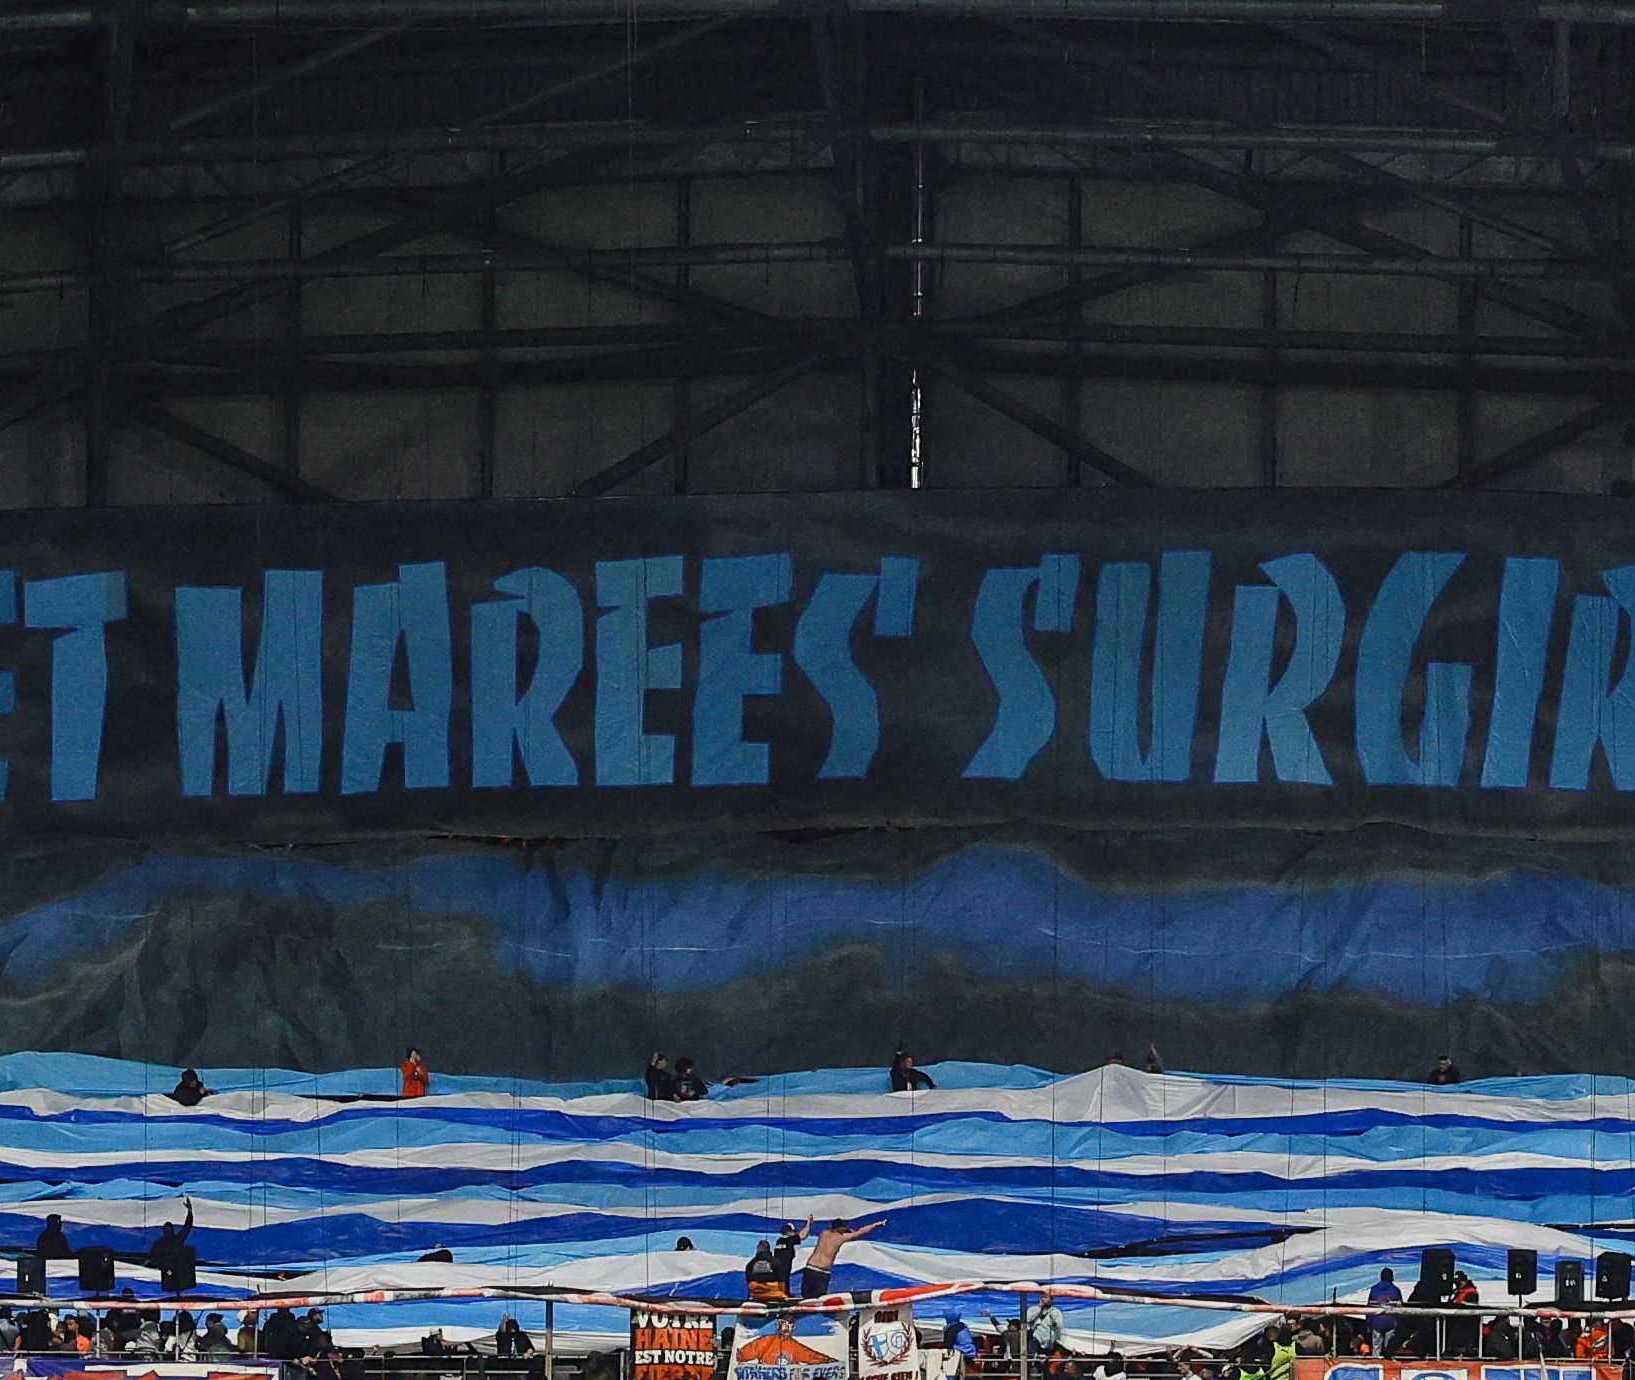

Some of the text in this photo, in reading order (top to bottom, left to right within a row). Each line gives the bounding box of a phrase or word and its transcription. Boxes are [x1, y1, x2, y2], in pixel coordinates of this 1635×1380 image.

[174, 554, 920, 797] MAREES
[635, 1328, 714, 1350] HAINE
[634, 1350, 714, 1366] EST NOTRE
